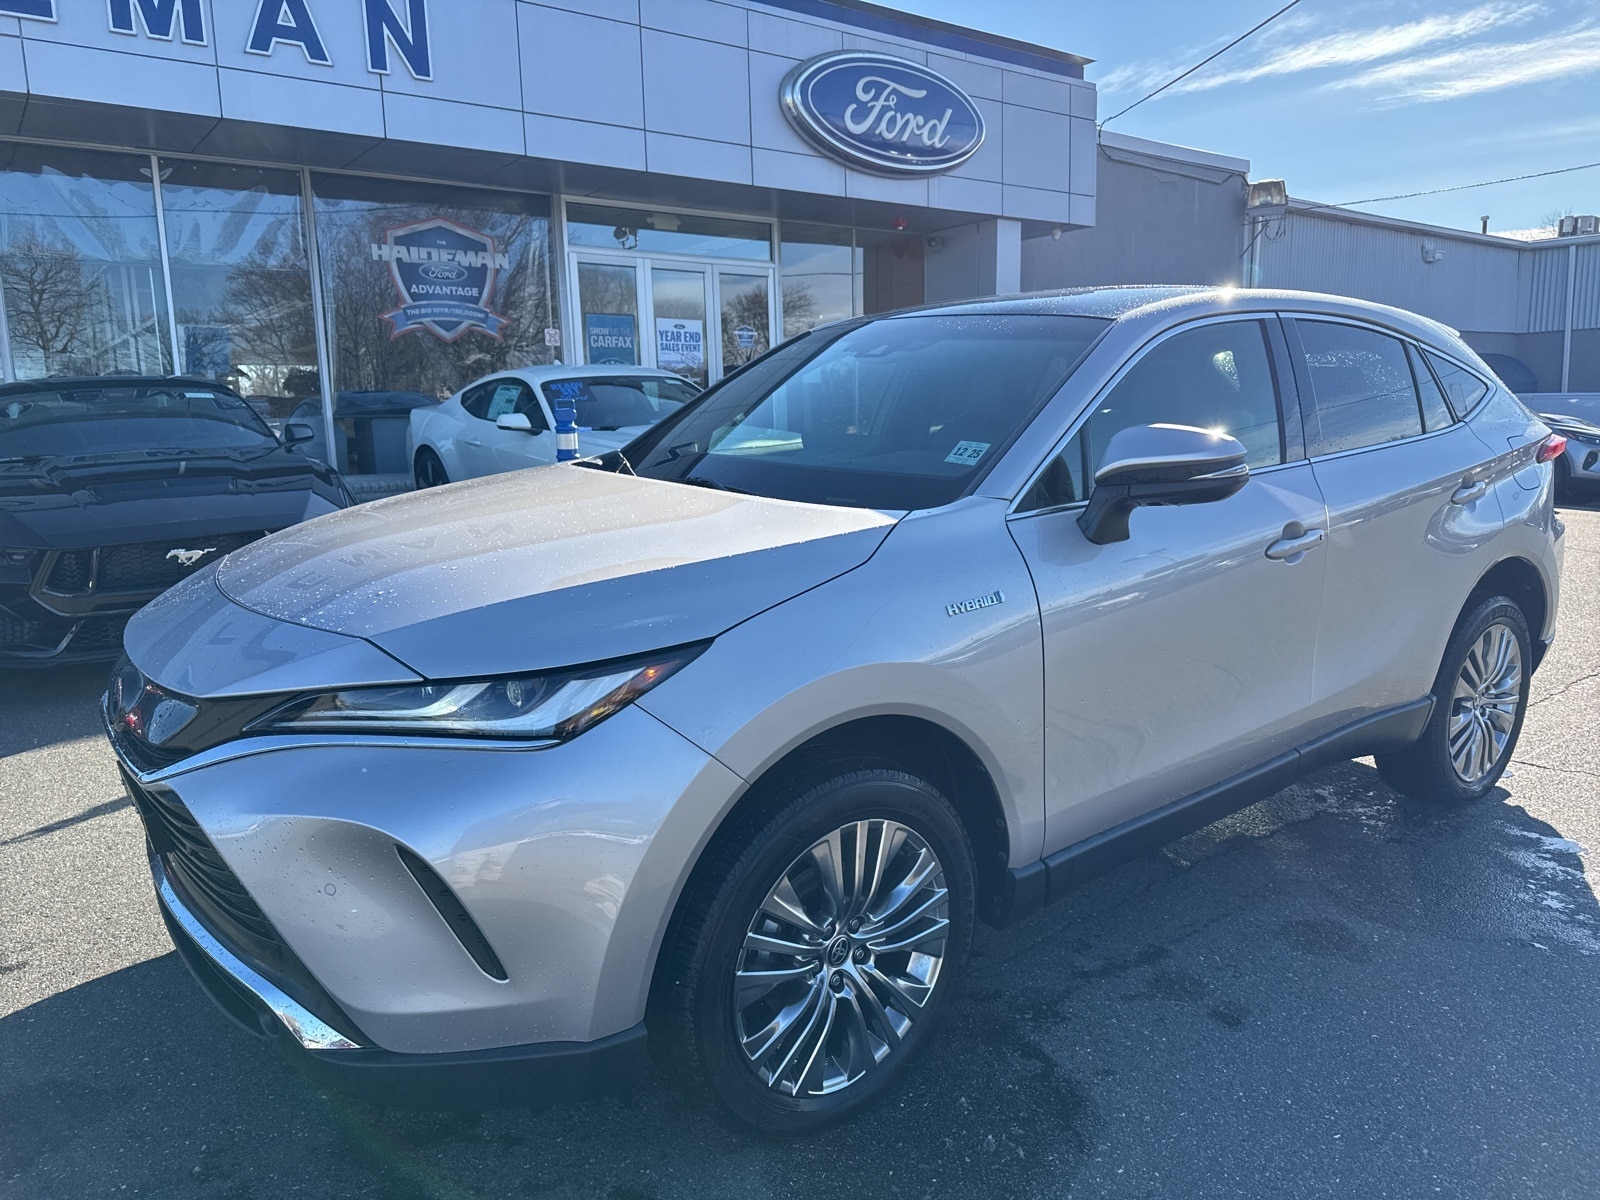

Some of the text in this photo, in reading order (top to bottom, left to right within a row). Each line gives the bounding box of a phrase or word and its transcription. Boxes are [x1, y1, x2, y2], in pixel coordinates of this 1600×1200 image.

[844, 75, 953, 149] Ford
[428, 265, 459, 280] Ford
[410, 284, 479, 297] ADVANTAGE
[406, 308, 420, 316] THE
[420, 307, 432, 315] BIG
[589, 327, 632, 336] SHOW ME THE
[658, 330, 701, 343] YEAR END
[590, 335, 633, 349] CARFAX
[660, 343, 680, 352] SALES
[681, 343, 701, 353] EVENT
[550, 381, 584, 391] READY
[953, 447, 982, 459] 12 25
[945, 594, 999, 617] HYBRID
